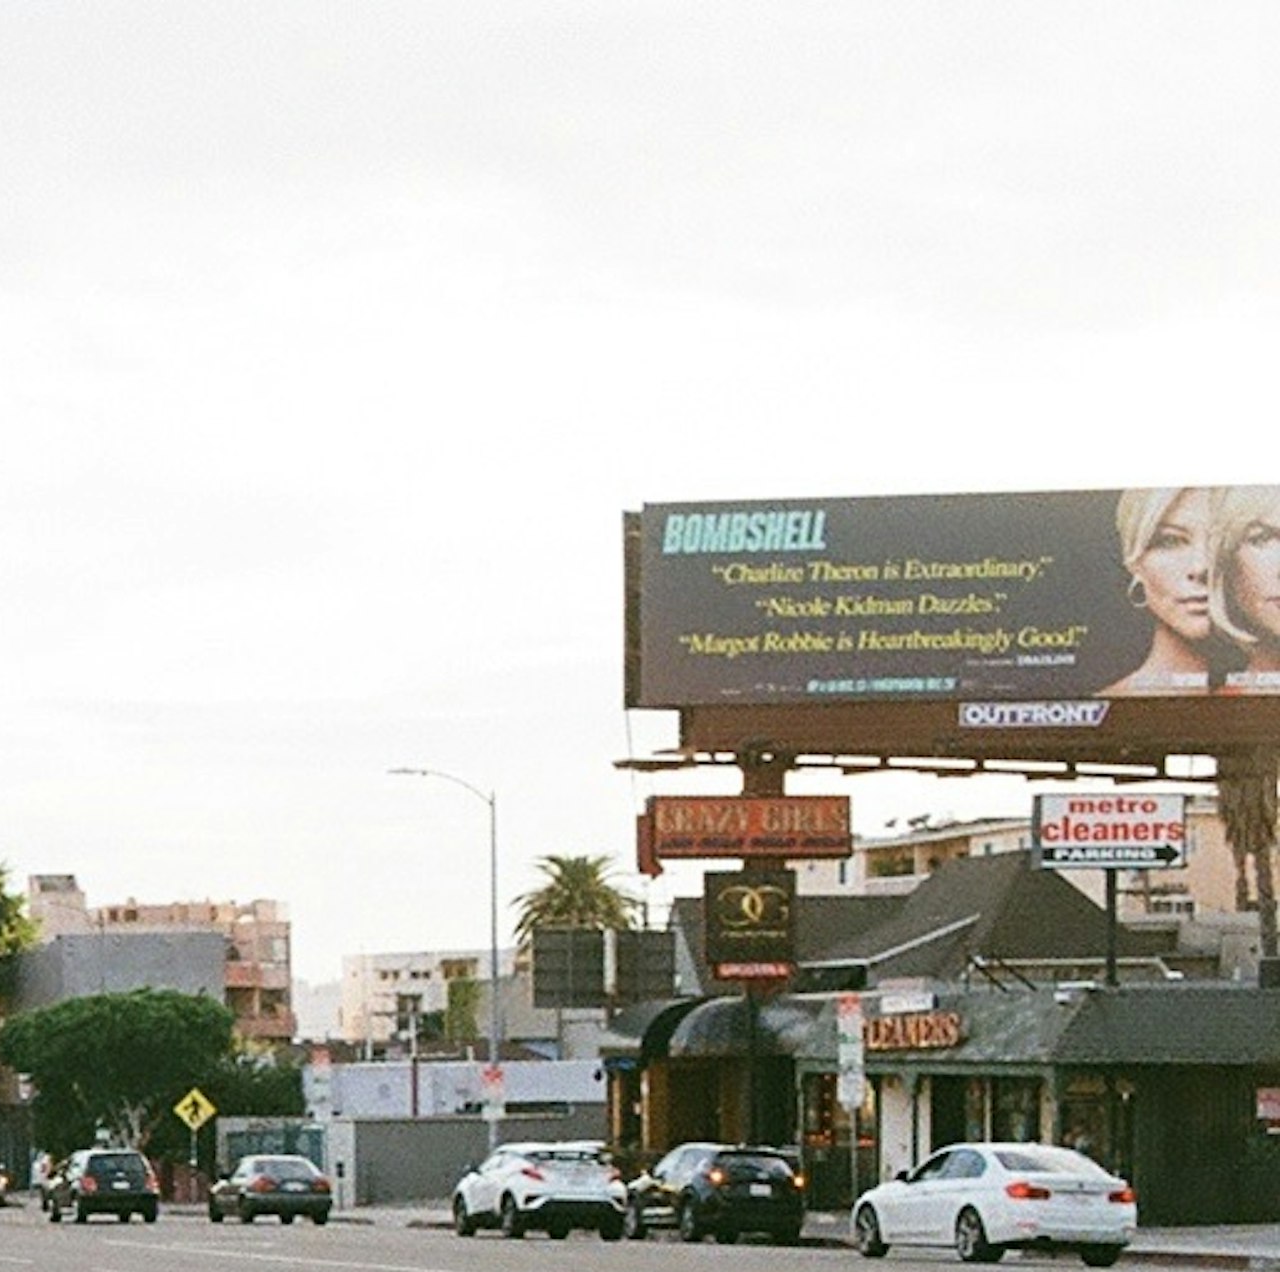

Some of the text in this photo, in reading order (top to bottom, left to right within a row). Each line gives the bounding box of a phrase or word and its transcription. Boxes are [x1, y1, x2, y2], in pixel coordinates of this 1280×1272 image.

[662, 510, 826, 554] BOMBSHELL
[883, 559, 899, 580] is
[836, 595, 913, 616] Kidman
[763, 630, 834, 652] Robbie
[836, 629, 854, 651] is
[1068, 797, 1158, 814] metro
[1041, 815, 1186, 842] cleaners
[1054, 847, 1157, 860] PARKING
[861, 1011, 960, 1051] LEANERS
